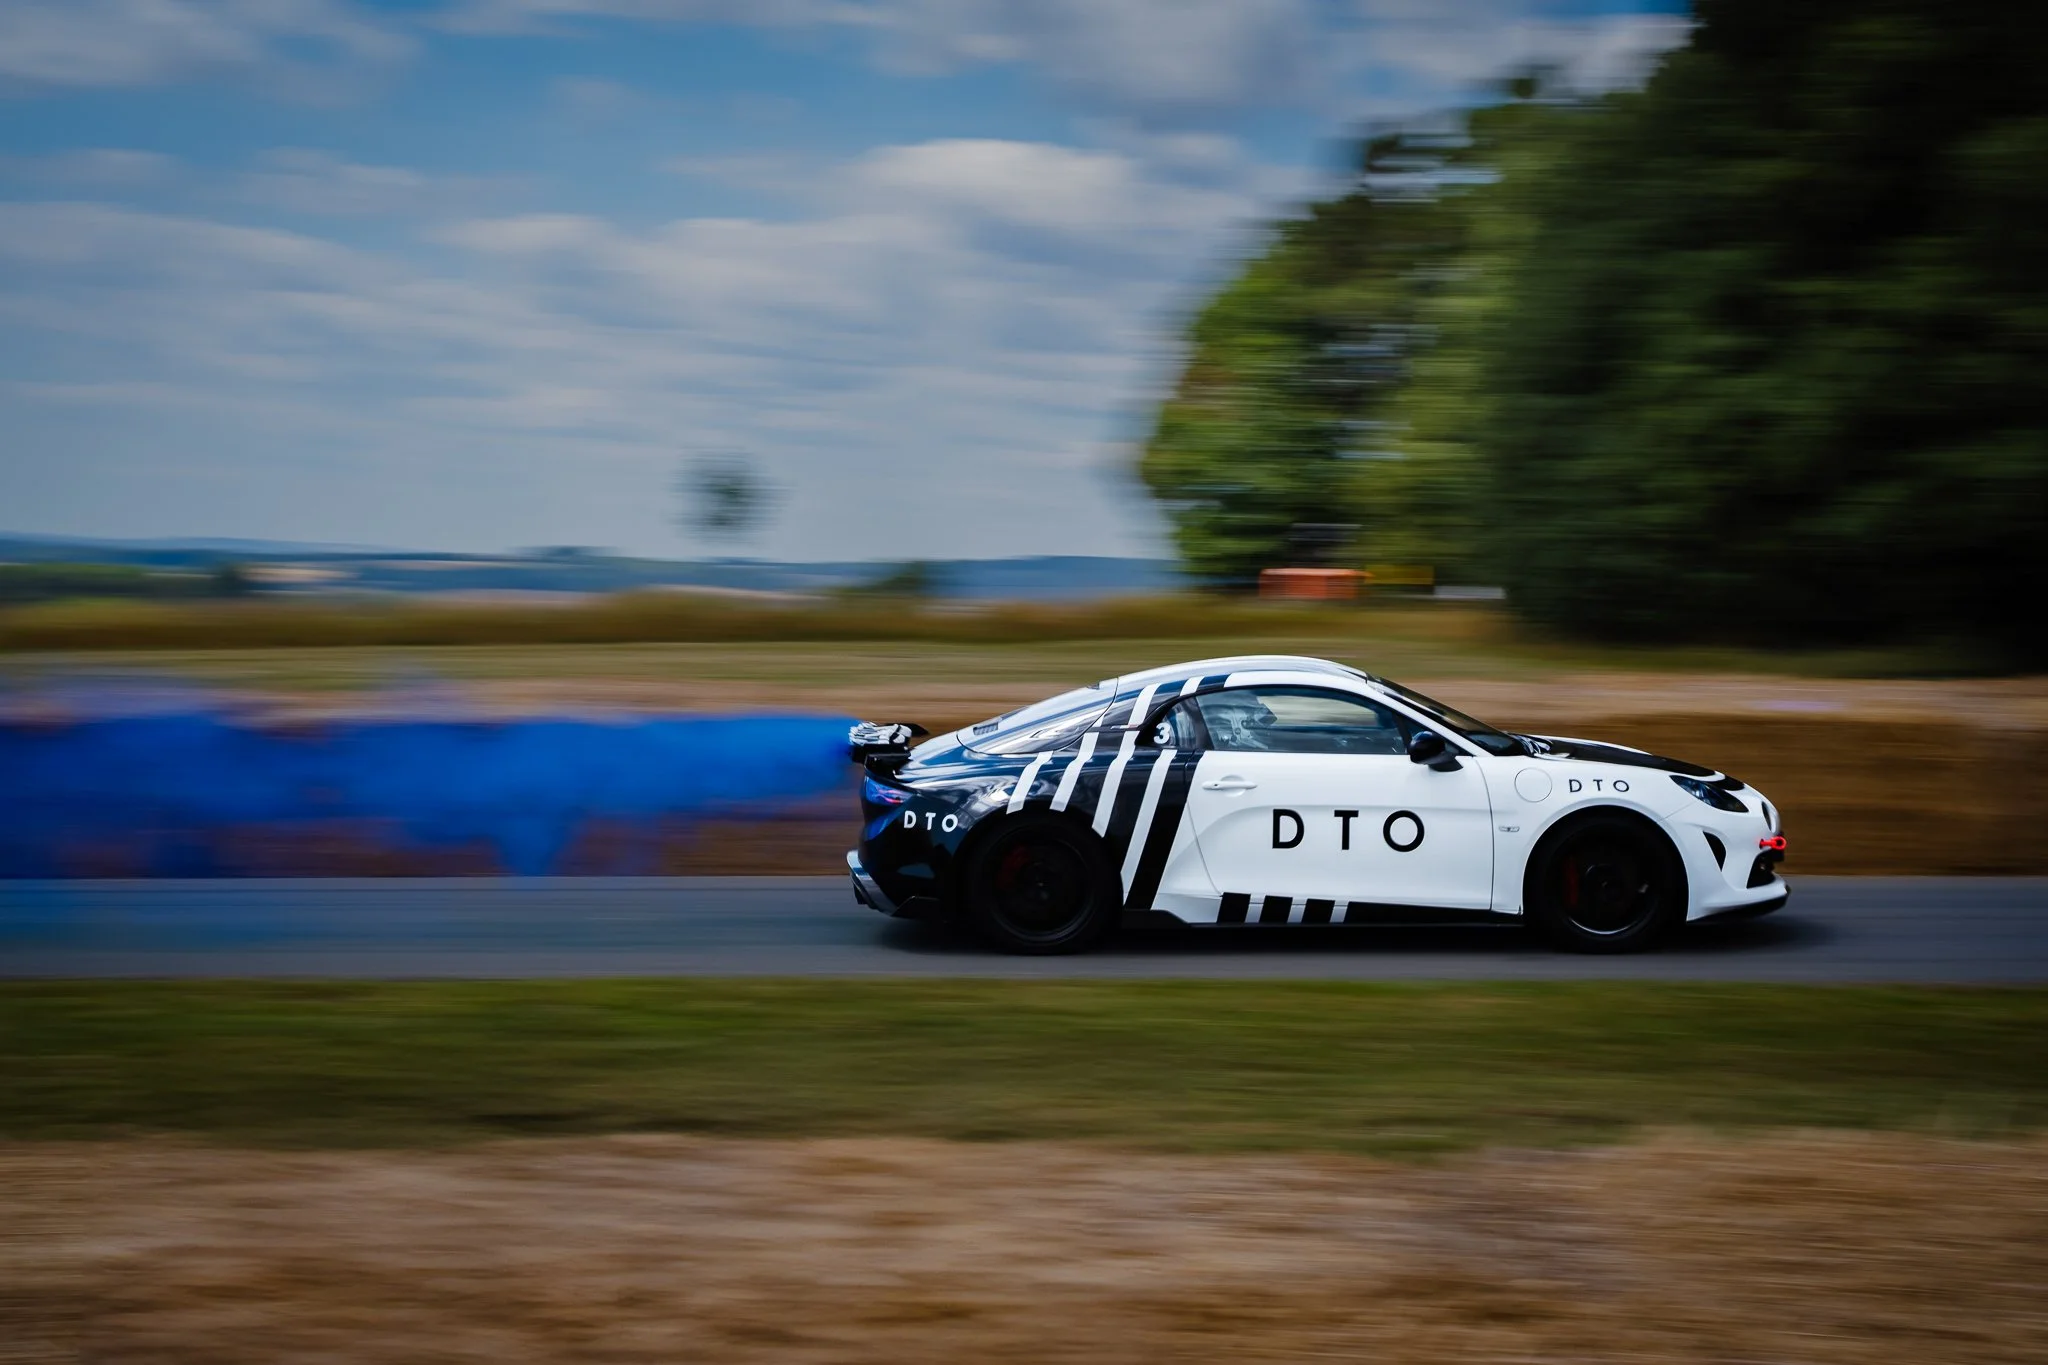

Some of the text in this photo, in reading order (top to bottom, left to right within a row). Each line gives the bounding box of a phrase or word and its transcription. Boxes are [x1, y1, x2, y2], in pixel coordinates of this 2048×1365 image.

[1153, 722, 1171, 744] 3
[1568, 779, 1630, 793] DTO
[903, 810, 959, 833] DTO
[1272, 808, 1425, 852] DTO
